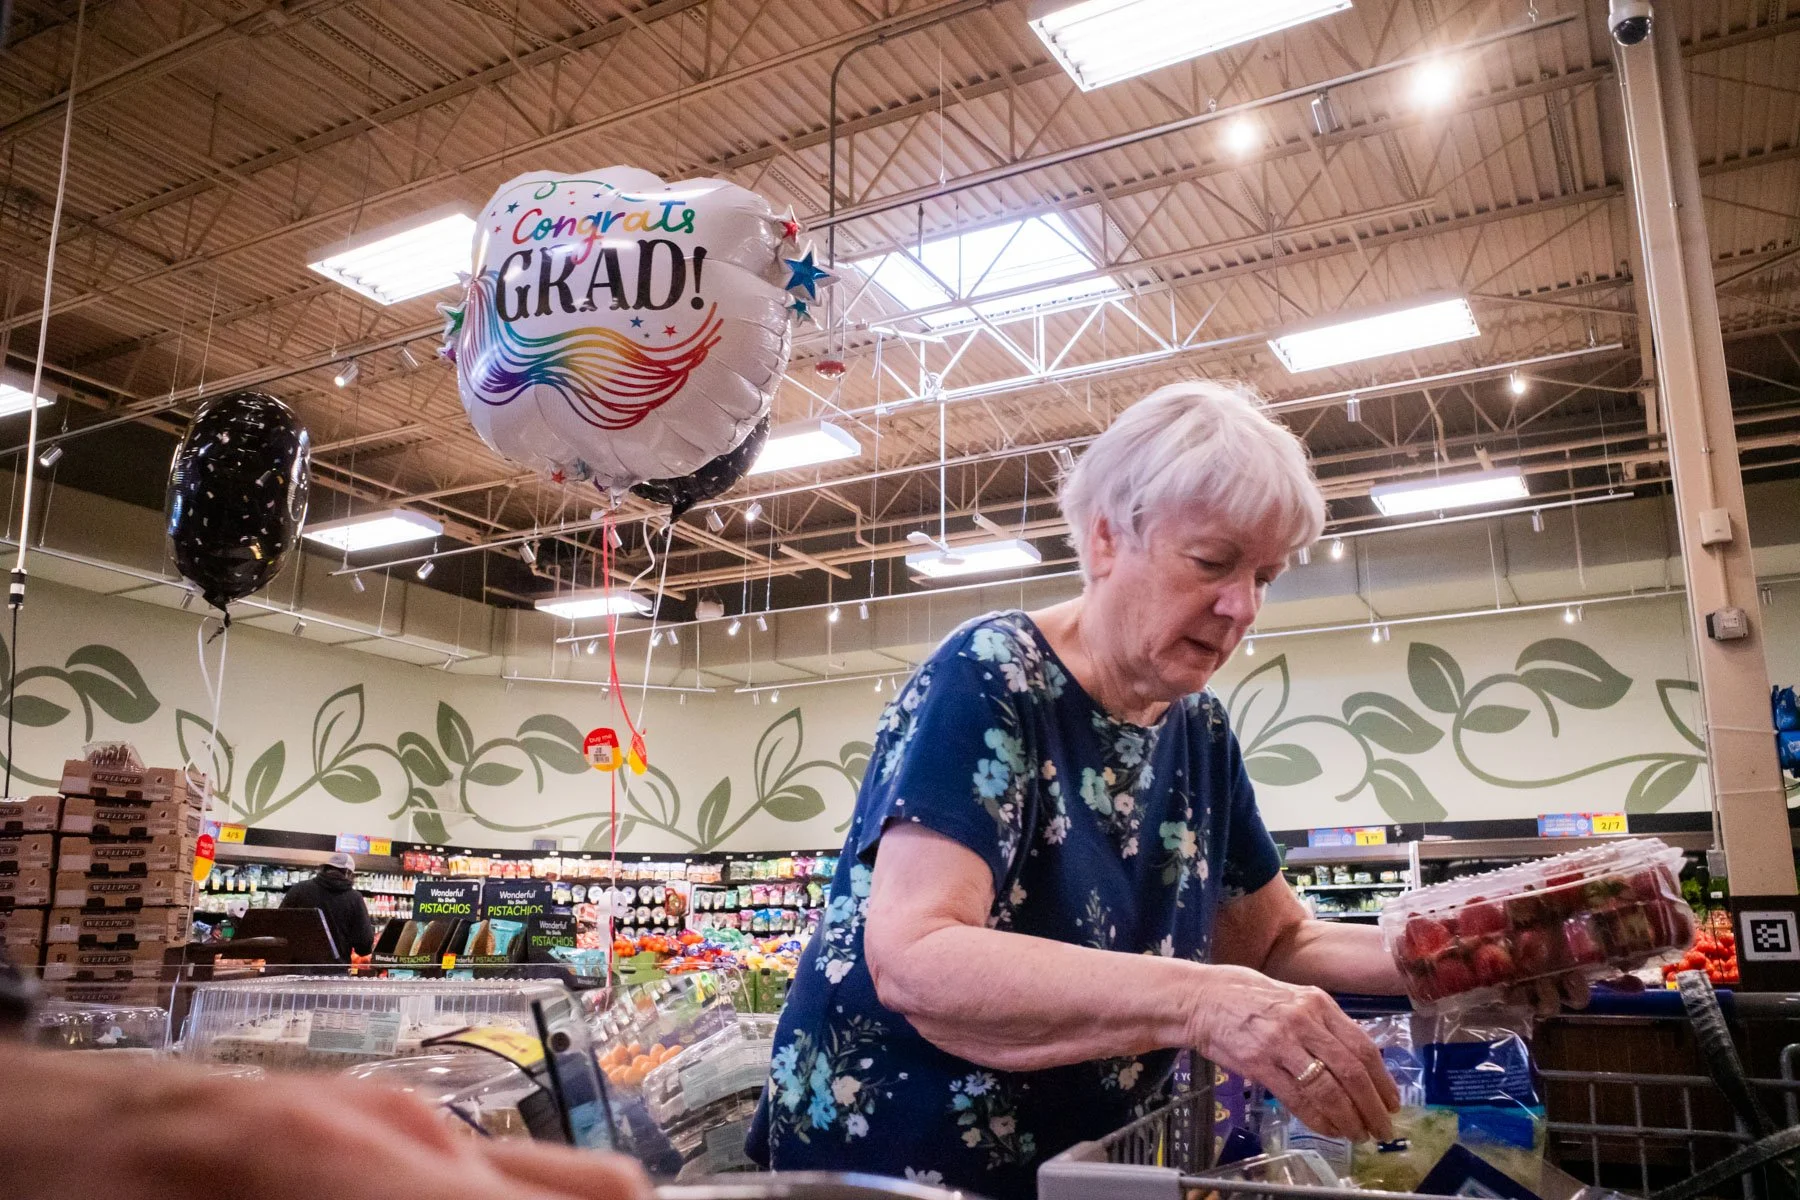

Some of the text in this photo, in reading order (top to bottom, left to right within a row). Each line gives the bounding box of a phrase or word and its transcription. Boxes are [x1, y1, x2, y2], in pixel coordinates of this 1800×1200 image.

[511, 199, 696, 264] Congrats
[495, 238, 708, 322] GRAD!
[430, 888, 466, 897] Wonderful
[499, 890, 536, 899] Wonderful
[419, 903, 471, 914] PISTACHIOS
[487, 905, 544, 916] PISTACHIOS
[539, 920, 567, 930] Wonderful
[531, 935, 574, 947] PISTACHIOS
[399, 955, 431, 964] PISTACHIOS
